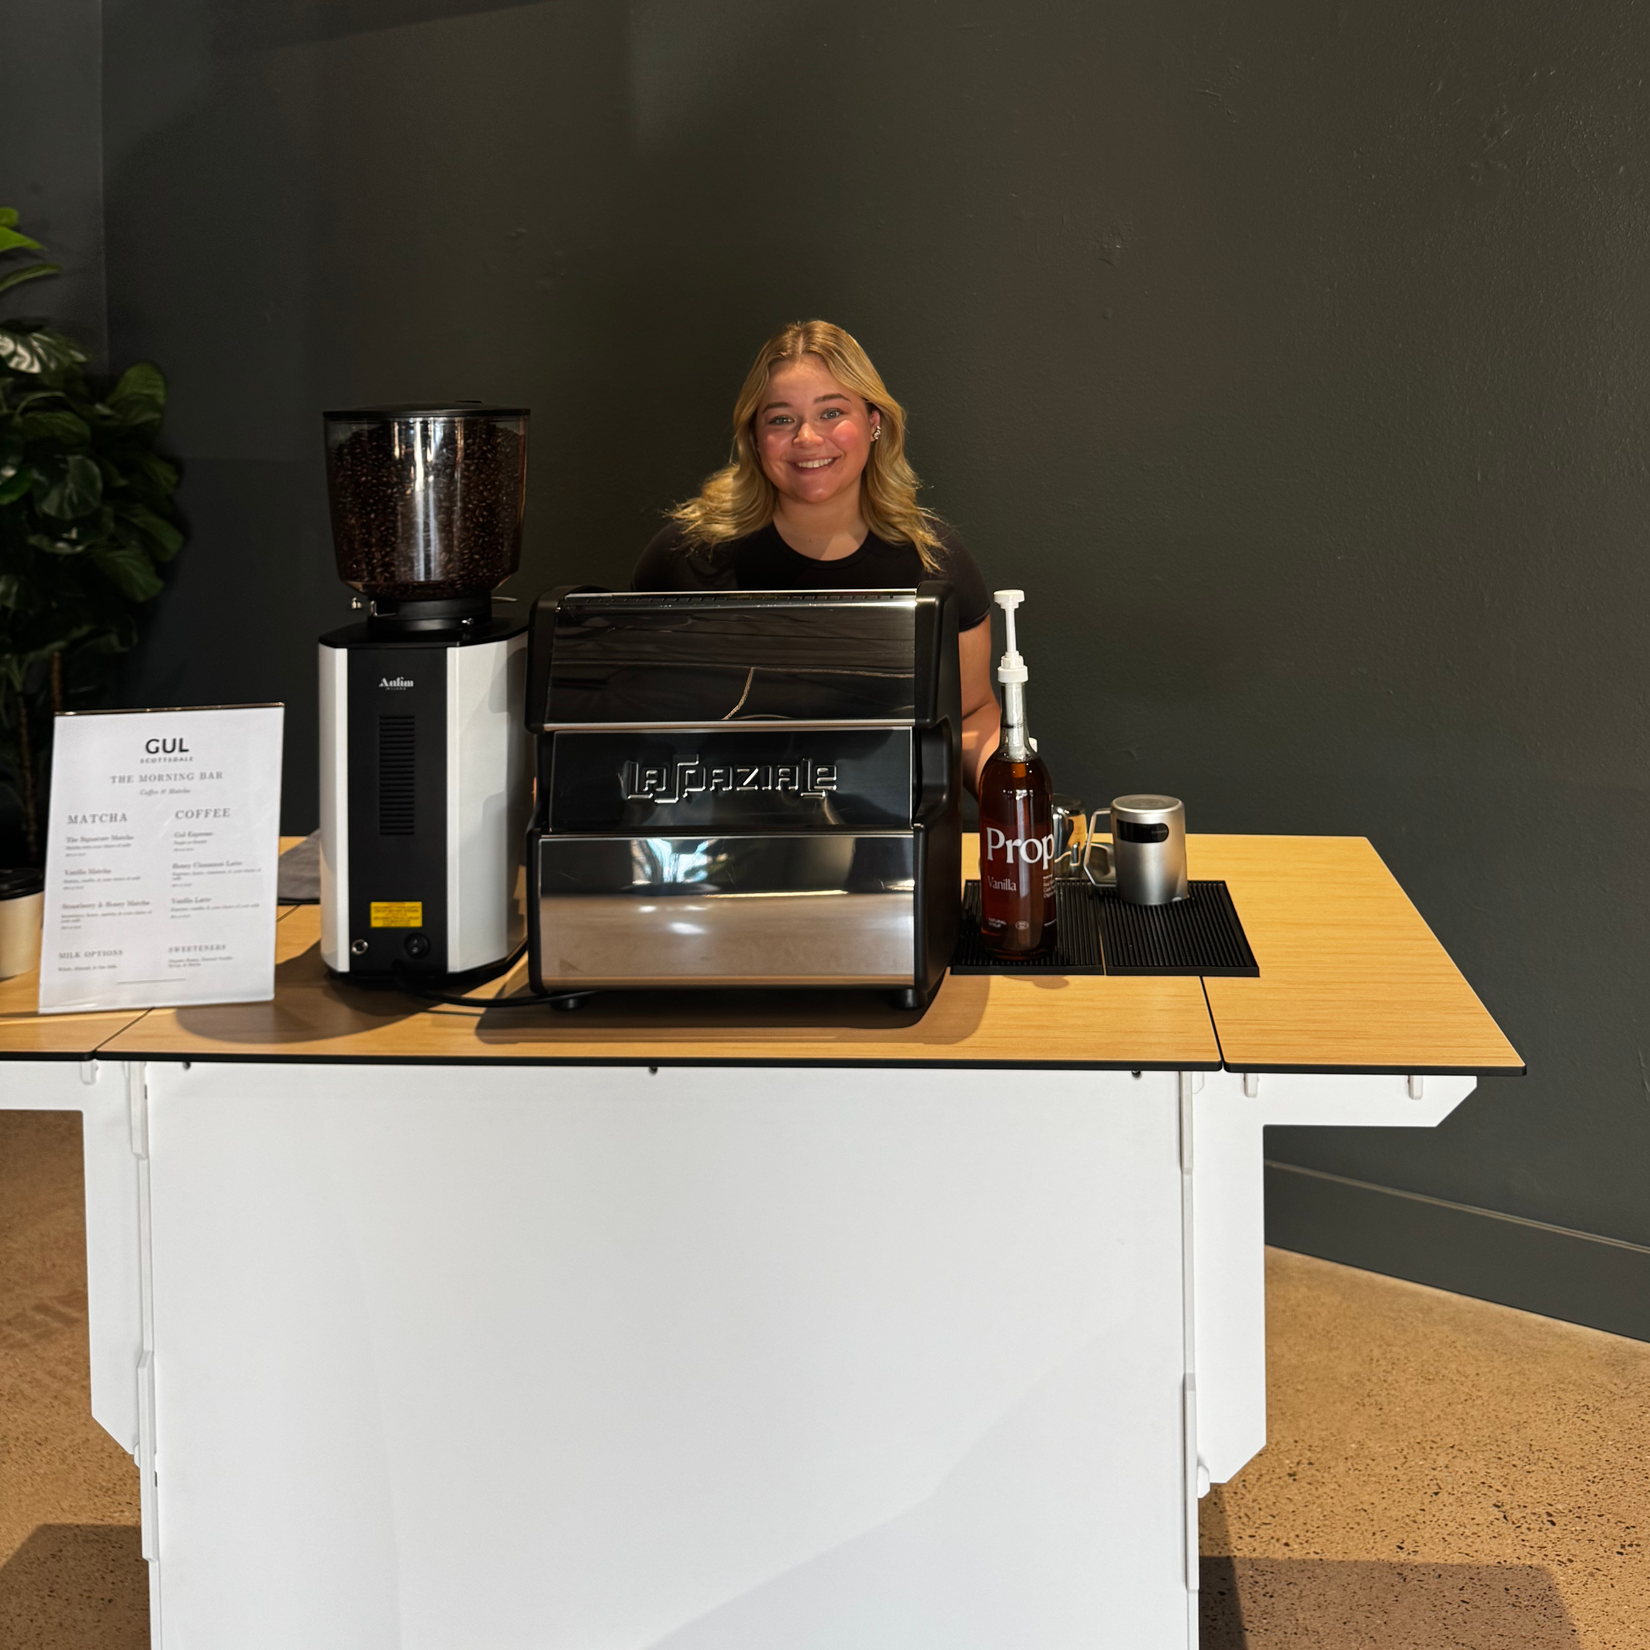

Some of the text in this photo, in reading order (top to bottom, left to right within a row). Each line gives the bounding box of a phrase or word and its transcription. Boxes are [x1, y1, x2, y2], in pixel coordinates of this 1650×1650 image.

[145, 738, 190, 754] GUL
[140, 756, 194, 765] SCOTTSDALE
[110, 771, 224, 785] THE MORNING BAR
[67, 812, 128, 825] MATCHA
[174, 807, 231, 820] COFFEE
[986, 826, 1055, 871] Prop
[988, 875, 1017, 892] Vanilla
[58, 949, 124, 959] MILK OPTIONS
